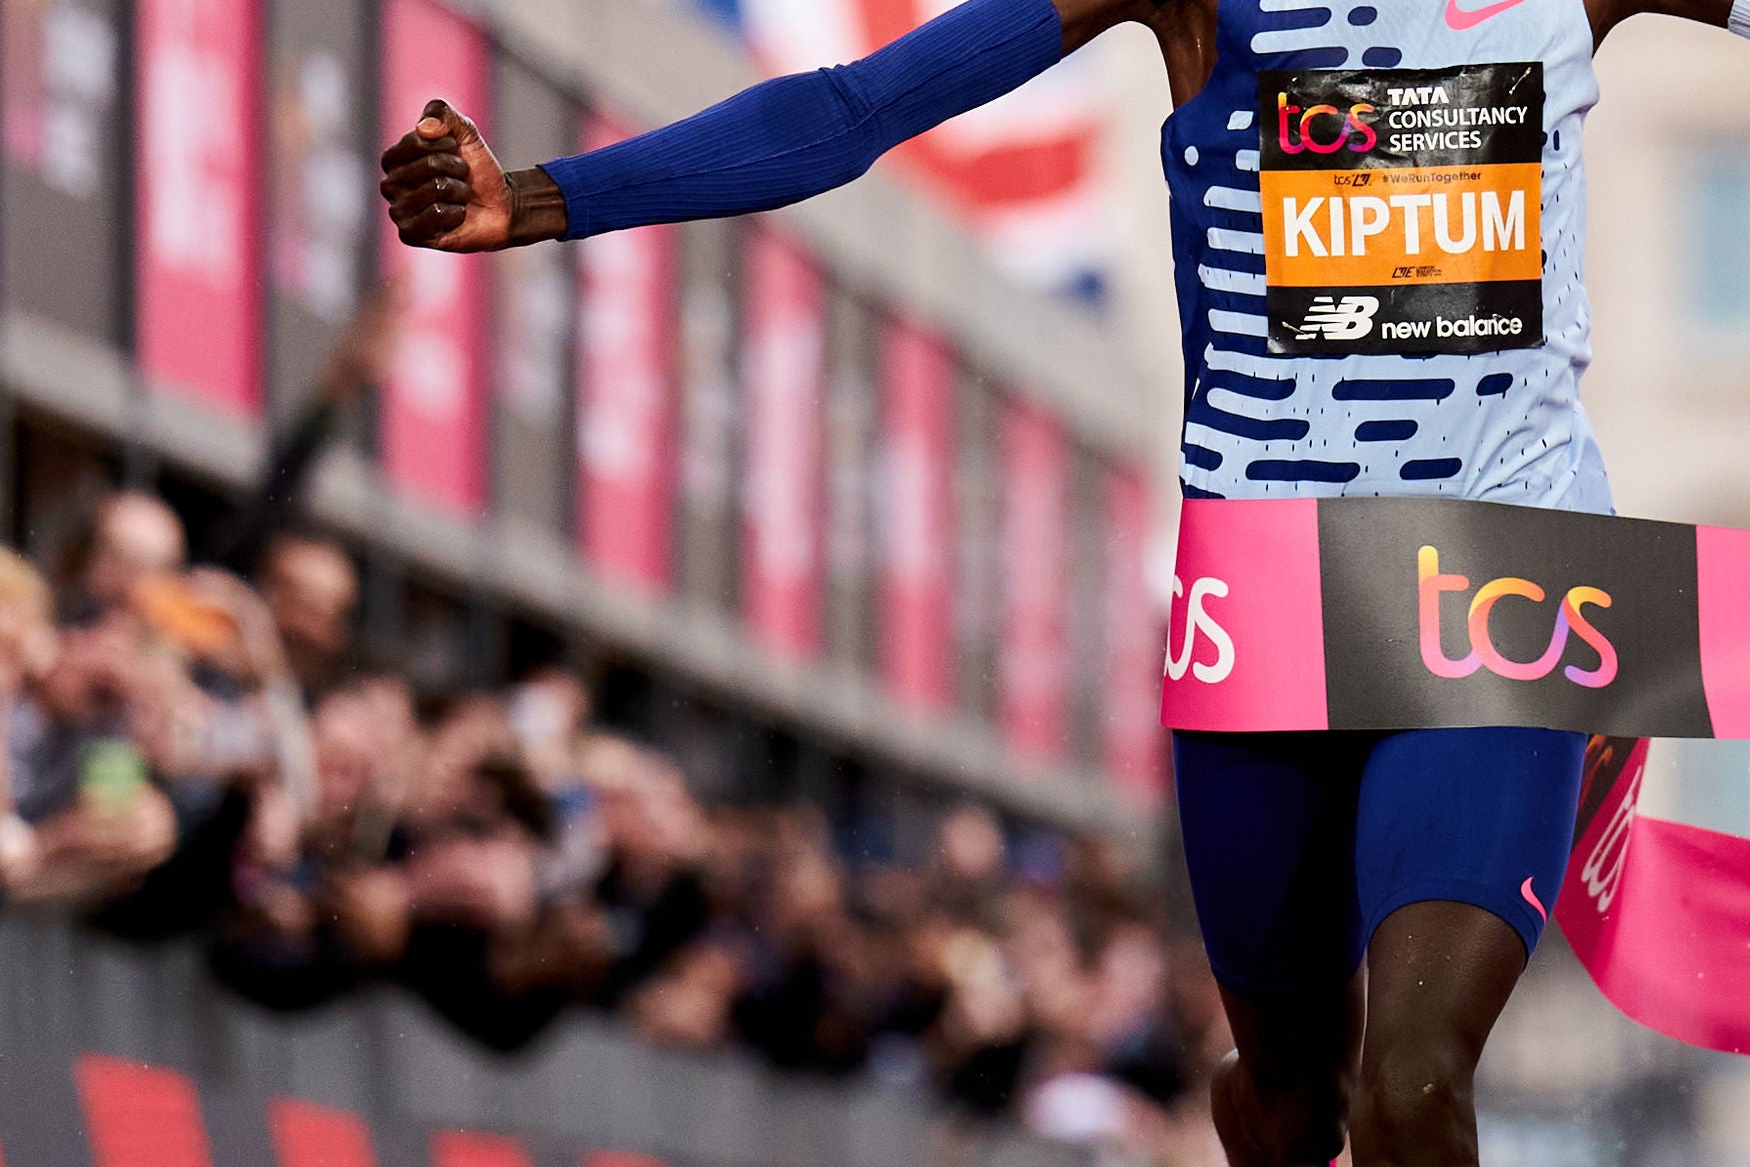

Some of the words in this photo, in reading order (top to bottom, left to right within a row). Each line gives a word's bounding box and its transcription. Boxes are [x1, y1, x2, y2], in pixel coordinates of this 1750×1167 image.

[1387, 86, 1449, 106] TATA
[1277, 92, 1378, 154] tcs
[1388, 106, 1528, 130] CONSULTANCY
[1389, 130, 1482, 152] SERVICES
[1383, 171, 1481, 184] #WeRunTogether
[1282, 189, 1526, 257] KIPTUM
[1382, 320, 1432, 340] new
[1436, 314, 1522, 338] balance
[1163, 574, 1235, 684] cs
[1418, 545, 1619, 689] tcs
